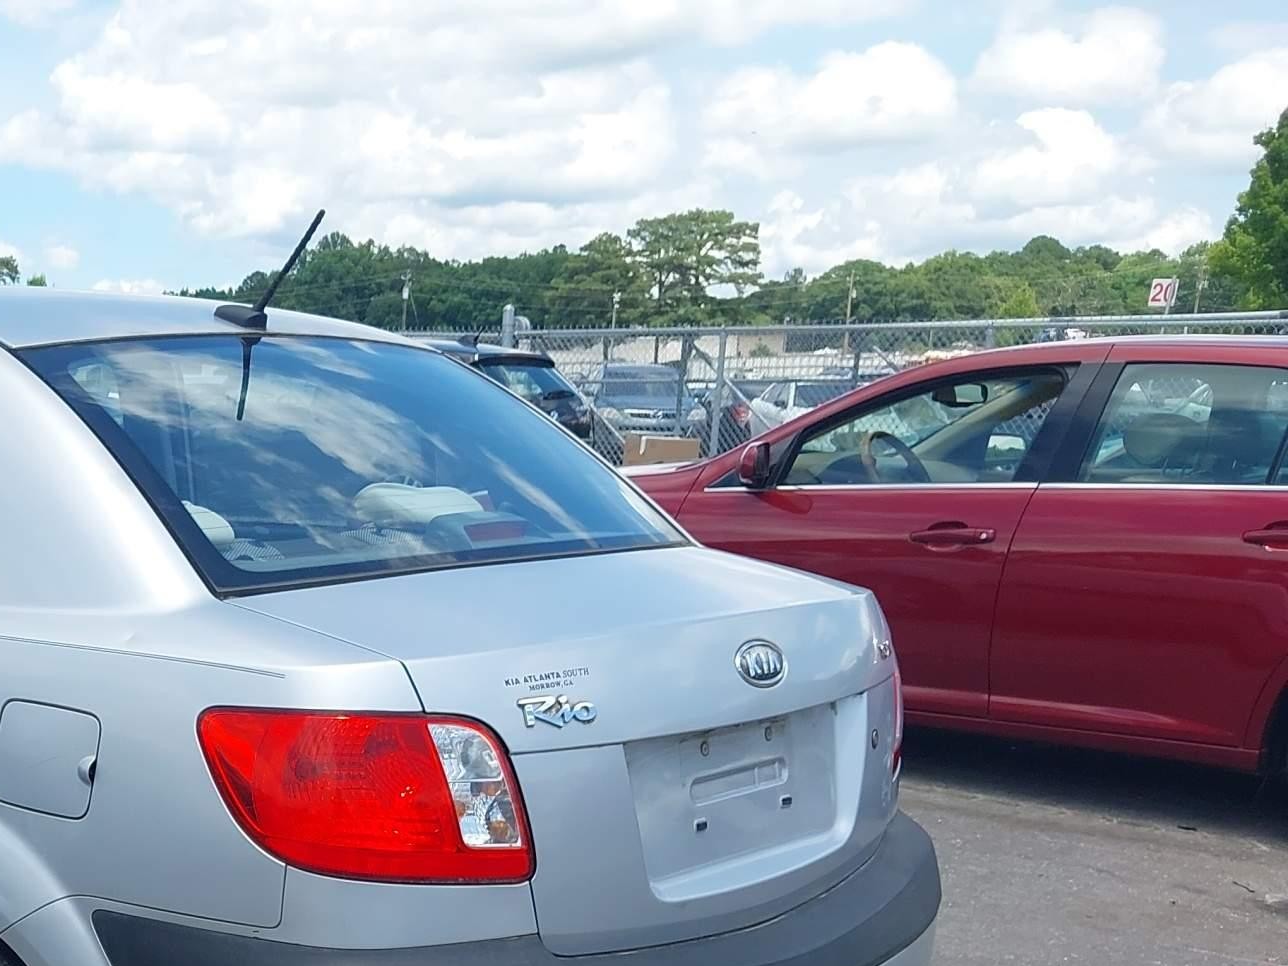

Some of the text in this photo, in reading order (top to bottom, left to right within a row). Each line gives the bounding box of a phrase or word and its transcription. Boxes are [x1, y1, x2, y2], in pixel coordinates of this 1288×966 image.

[1150, 283, 1176, 302] 20
[740, 645, 783, 679] KIA
[504, 667, 590, 687] KIA ATLANTA SOUTH
[516, 694, 598, 728] Rio
